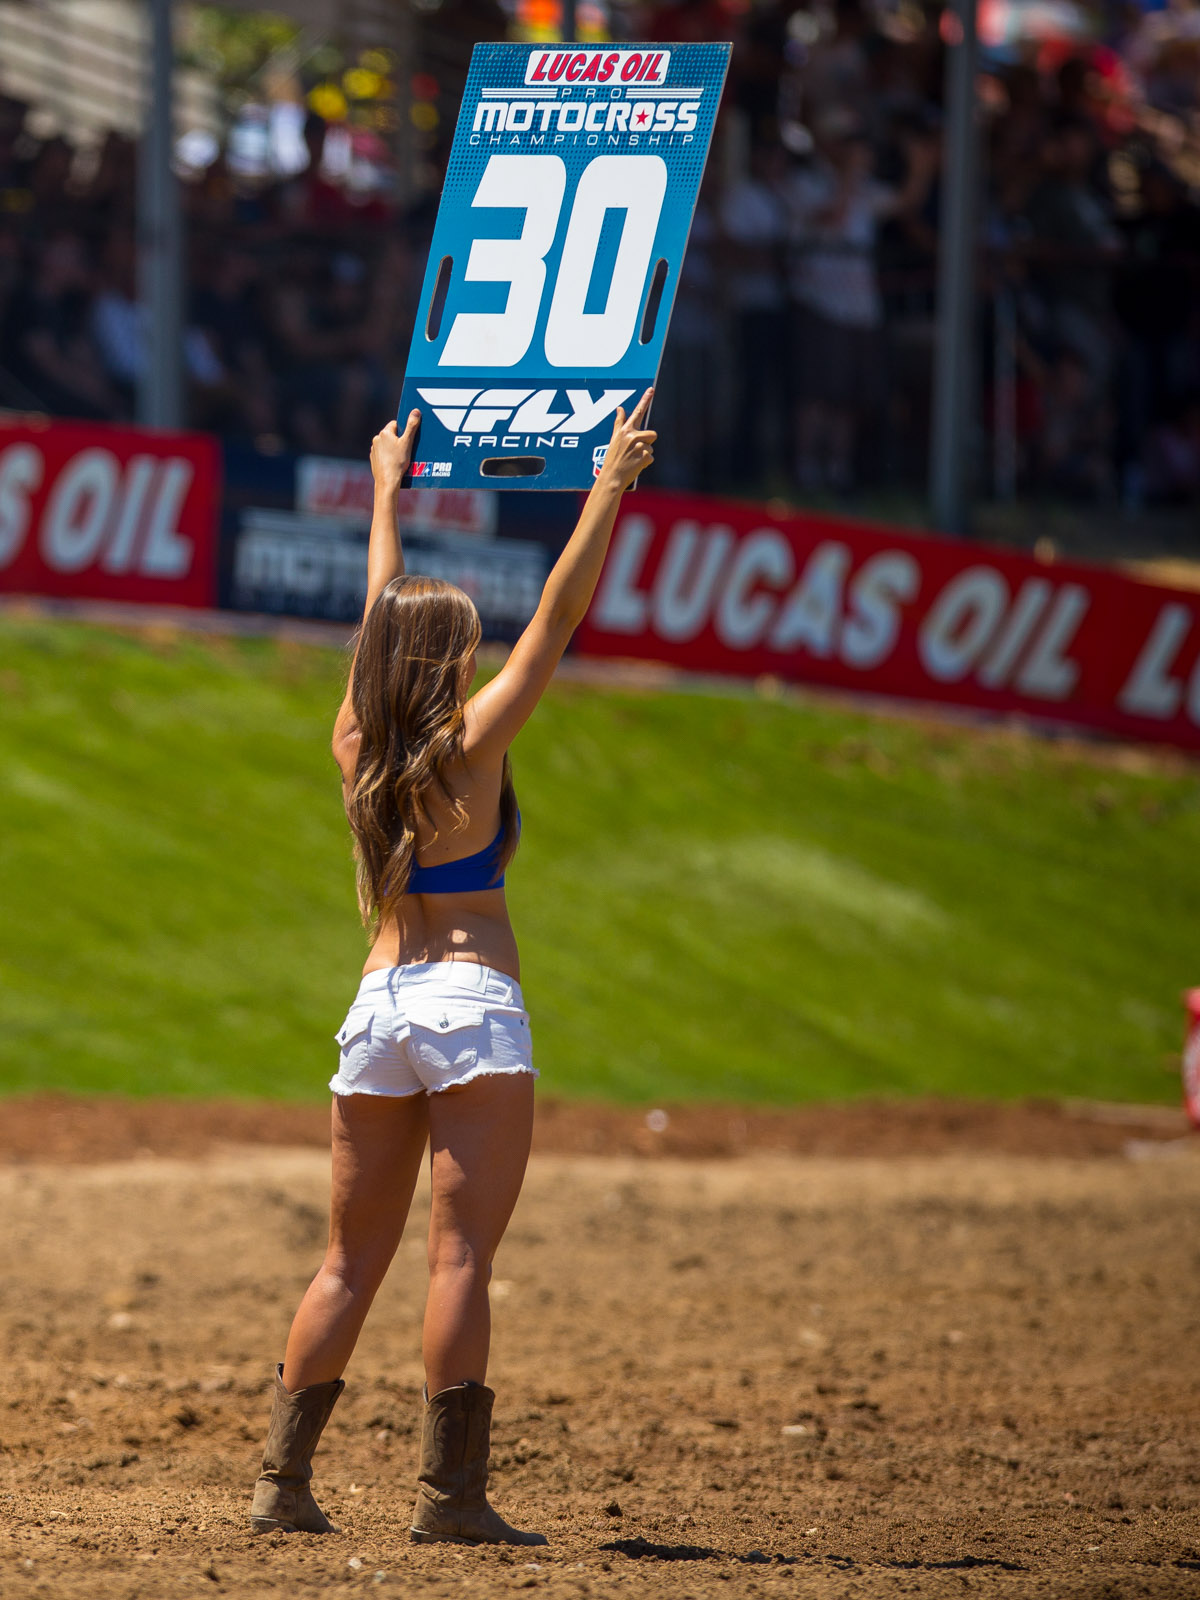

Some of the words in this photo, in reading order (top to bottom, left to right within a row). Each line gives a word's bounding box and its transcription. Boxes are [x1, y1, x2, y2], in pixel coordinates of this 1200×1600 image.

[530, 53, 620, 82] LUCAS
[620, 53, 664, 82] OIL
[561, 88, 622, 98] PRO
[472, 102, 701, 131] MOTOCROSS
[469, 134, 694, 145] CHAMPIONSHIP
[438, 155, 668, 367] 30
[416, 388, 636, 433] FLY
[453, 435, 580, 447] RACING
[433, 461, 452, 472] PRO
[38, 446, 197, 578] OIL
[590, 512, 922, 671] LUCAS
[917, 565, 1090, 699] OIL
